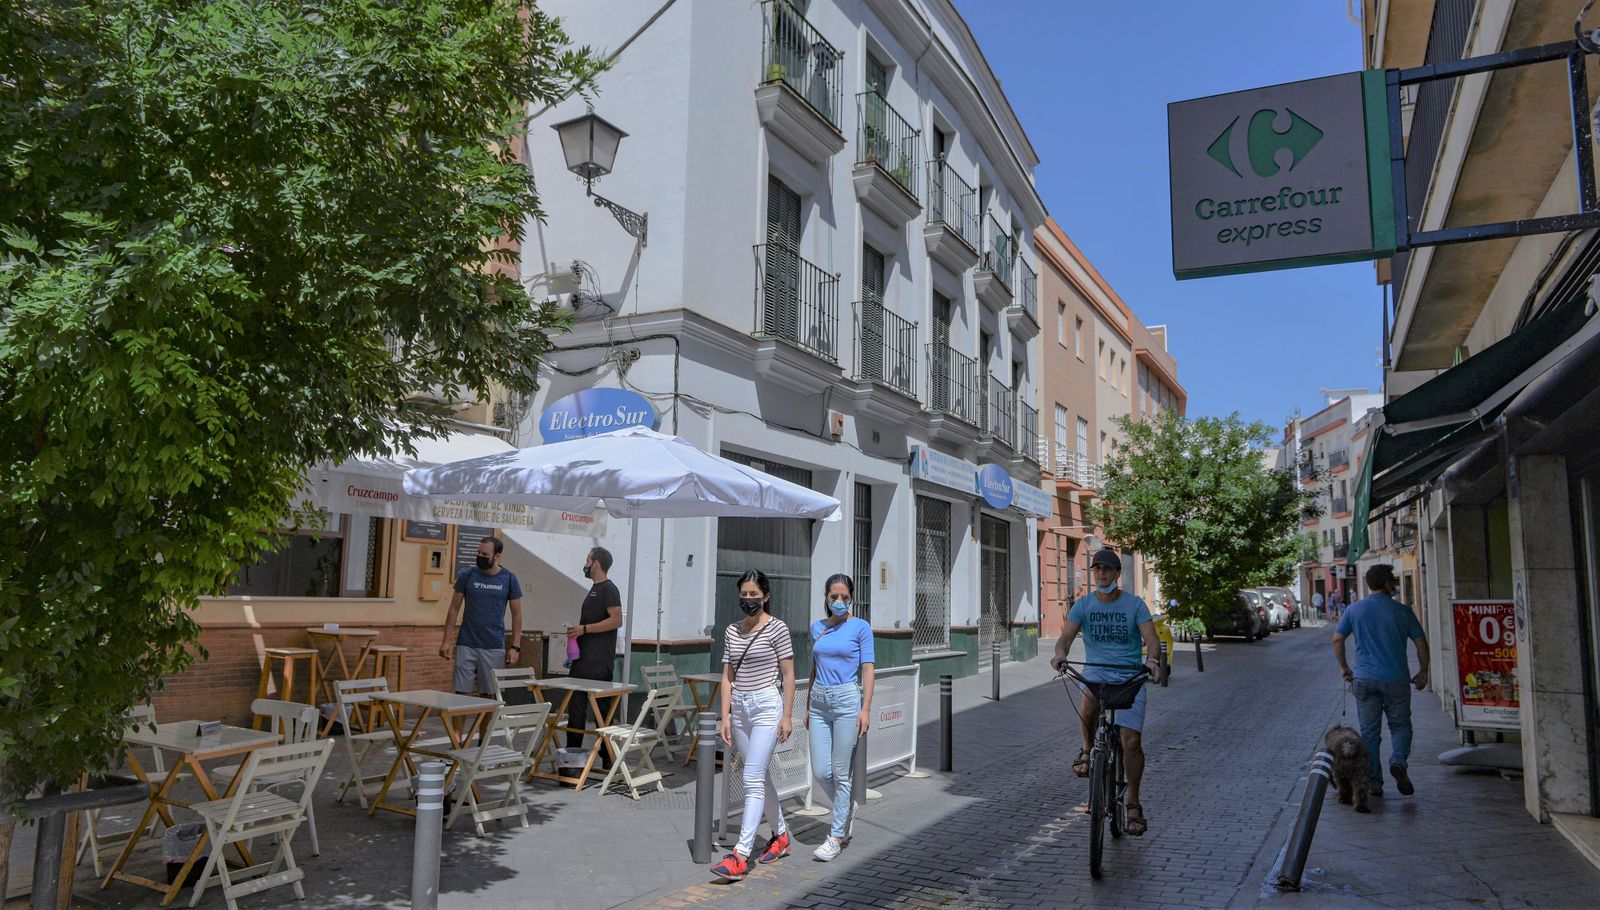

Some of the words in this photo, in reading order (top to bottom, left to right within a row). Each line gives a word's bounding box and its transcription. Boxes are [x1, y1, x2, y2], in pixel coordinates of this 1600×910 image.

[1195, 186, 1343, 220] Carrefour
[1216, 217, 1322, 246] express
[548, 405, 648, 431] ElectroSur
[347, 484, 399, 503] Cruzcampo
[432, 505, 463, 519] CERVEZA
[465, 508, 490, 522] TANQUE
[491, 511, 500, 523] DE
[501, 512, 534, 527] SALMUERA
[1089, 624, 1128, 635] FITNESS
